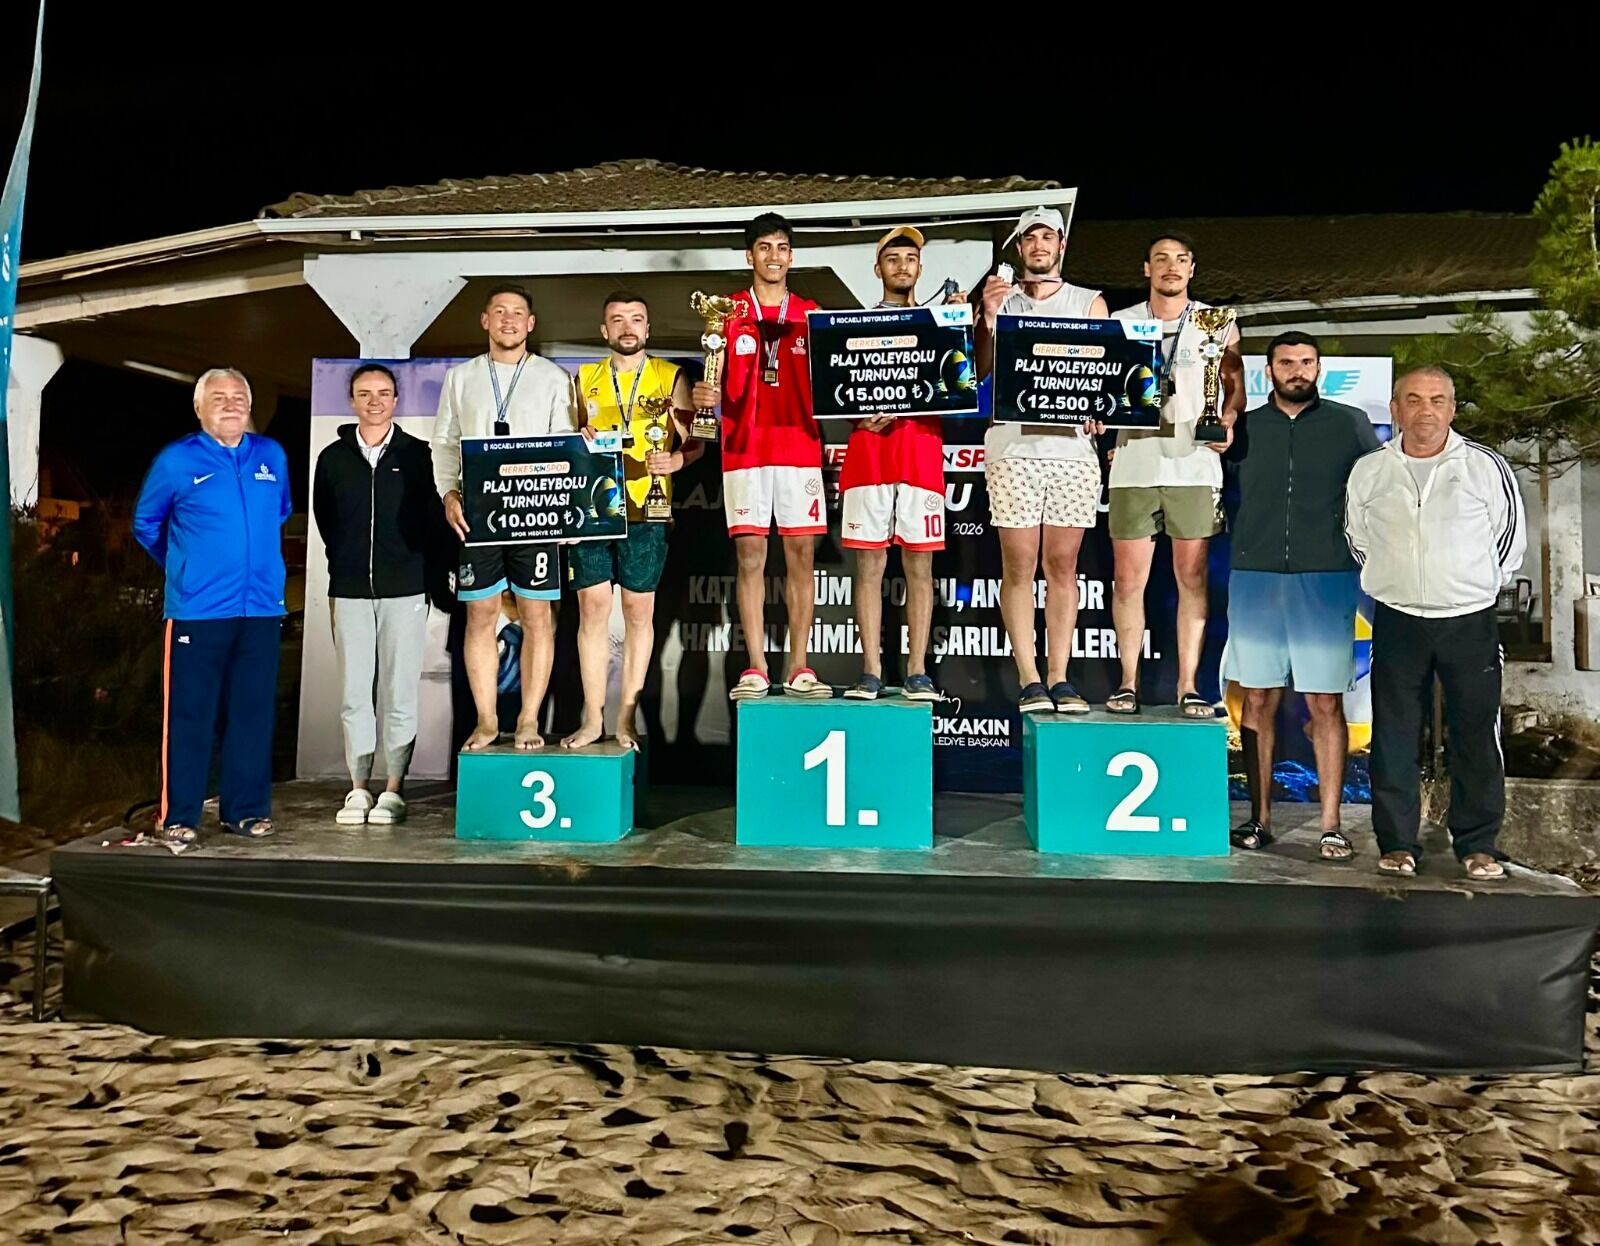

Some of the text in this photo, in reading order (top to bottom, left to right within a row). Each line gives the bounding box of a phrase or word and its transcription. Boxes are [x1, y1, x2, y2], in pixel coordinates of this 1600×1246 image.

[830, 350, 936, 367] PLAJ VOLEYBOLU
[1014, 358, 1122, 376] PLAJ VOLEYBOLU
[849, 367, 919, 383] TURNUVASI
[1033, 376, 1103, 392] TURNUVASI
[845, 385, 907, 402] 15.000
[859, 404, 875, 412] SPOR
[1027, 394, 1089, 411] 12.500
[955, 449, 985, 468] SP
[501, 464, 534, 474] HERKES
[545, 462, 568, 472] SPOR
[483, 476, 587, 494] PLAJ VOLEYBOLU
[502, 493, 570, 509] TURNUVASI
[808, 498, 820, 522] 4
[497, 512, 559, 529] 10.000
[924, 514, 942, 538] 10
[953, 523, 984, 536] 2026
[535, 552, 548, 579] 8
[813, 570, 852, 606] ÜM
[932, 716, 1010, 736] ÜKAKIN
[933, 736, 1010, 748] LEDİYE BAŞKANI
[802, 730, 880, 827] 1.
[519, 770, 573, 830] 3.
[1105, 751, 1188, 833] 2.
